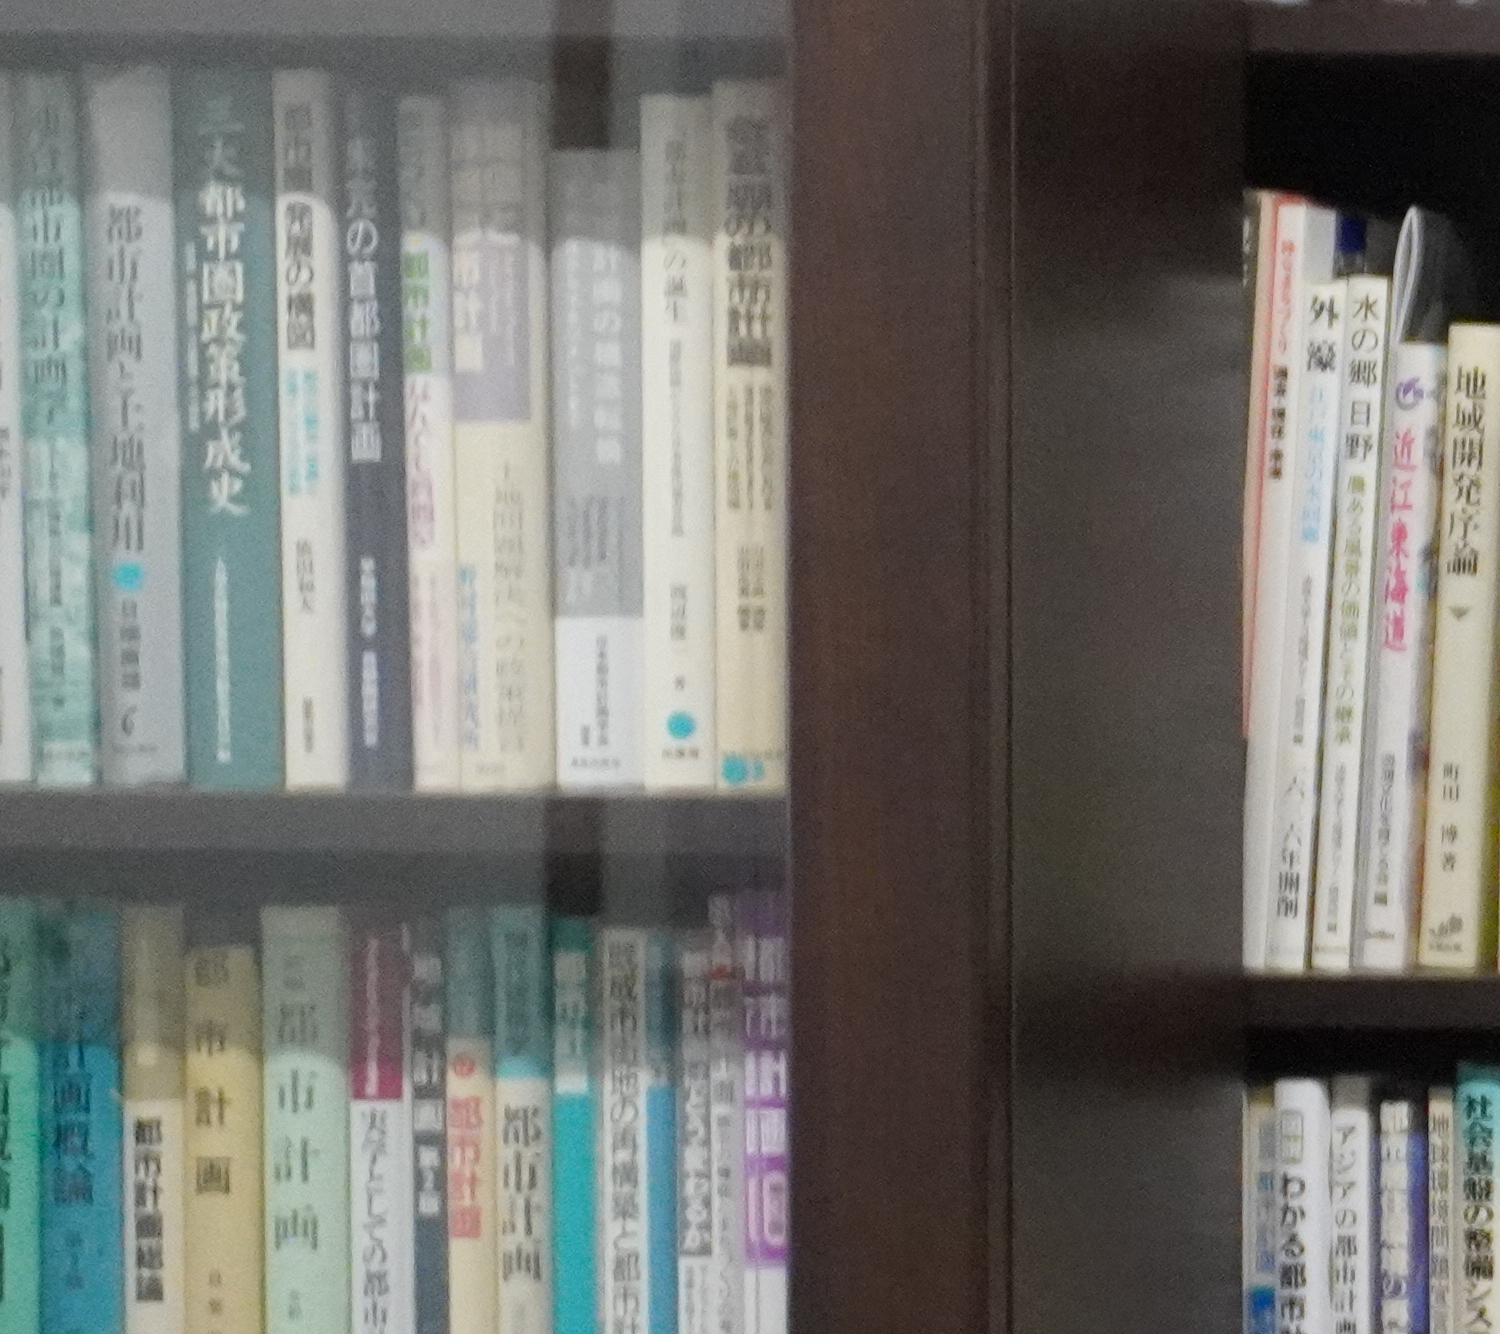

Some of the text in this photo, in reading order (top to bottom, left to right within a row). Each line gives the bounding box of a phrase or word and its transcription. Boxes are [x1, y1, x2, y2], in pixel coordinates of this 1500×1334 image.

[1445, 365, 1487, 577] 地域開発序論
